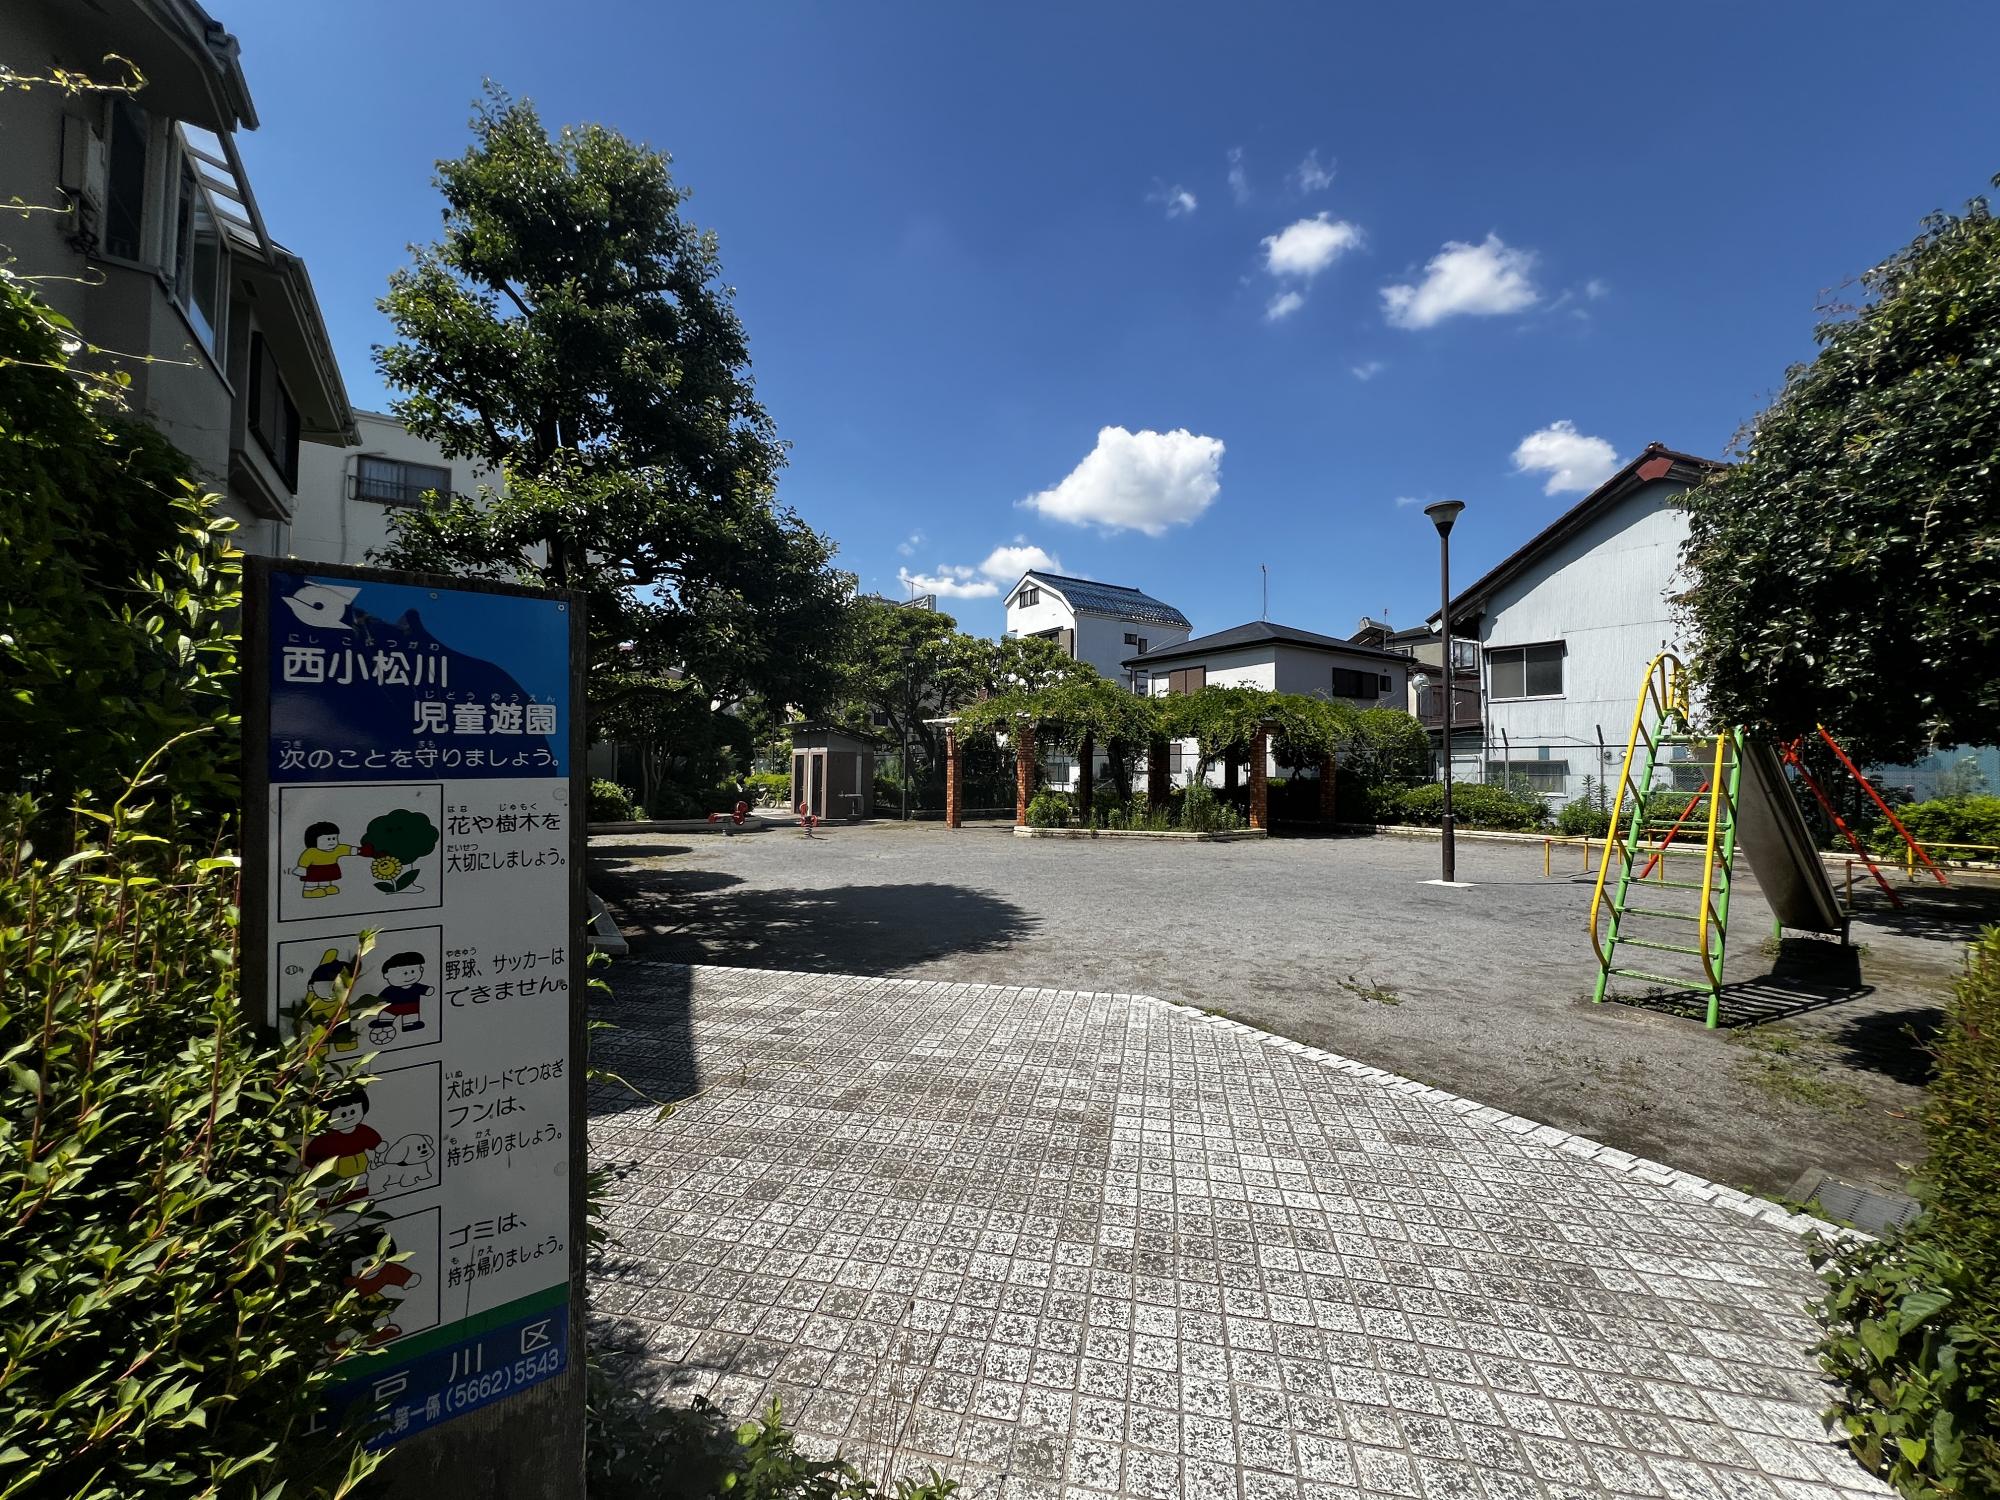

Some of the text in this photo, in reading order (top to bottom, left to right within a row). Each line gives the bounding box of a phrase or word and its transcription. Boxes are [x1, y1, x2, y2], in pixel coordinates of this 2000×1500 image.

[281, 646, 448, 688] 西小松川
[425, 690, 556, 703] じどうゆうえん
[412, 700, 557, 735] 児童遊園
[278, 747, 559, 770] 次のことを守りましょう。
[447, 805, 468, 813] はな
[447, 812, 561, 836] 花や樹木を
[446, 843, 479, 853] たいせつ
[447, 847, 566, 873] 大切にしましょう。
[445, 947, 565, 981] 野球、サッカーは
[445, 975, 568, 1007] できません。
[445, 1070, 463, 1080] いぬ
[446, 1058, 564, 1102] 犬はリードでつなぎ
[448, 1096, 526, 1128] フンは、
[447, 1123, 562, 1168] 持ち帰りましょう。
[448, 1212, 527, 1249] ゴミは、
[447, 1235, 564, 1288] 持ち帰りましょう。
